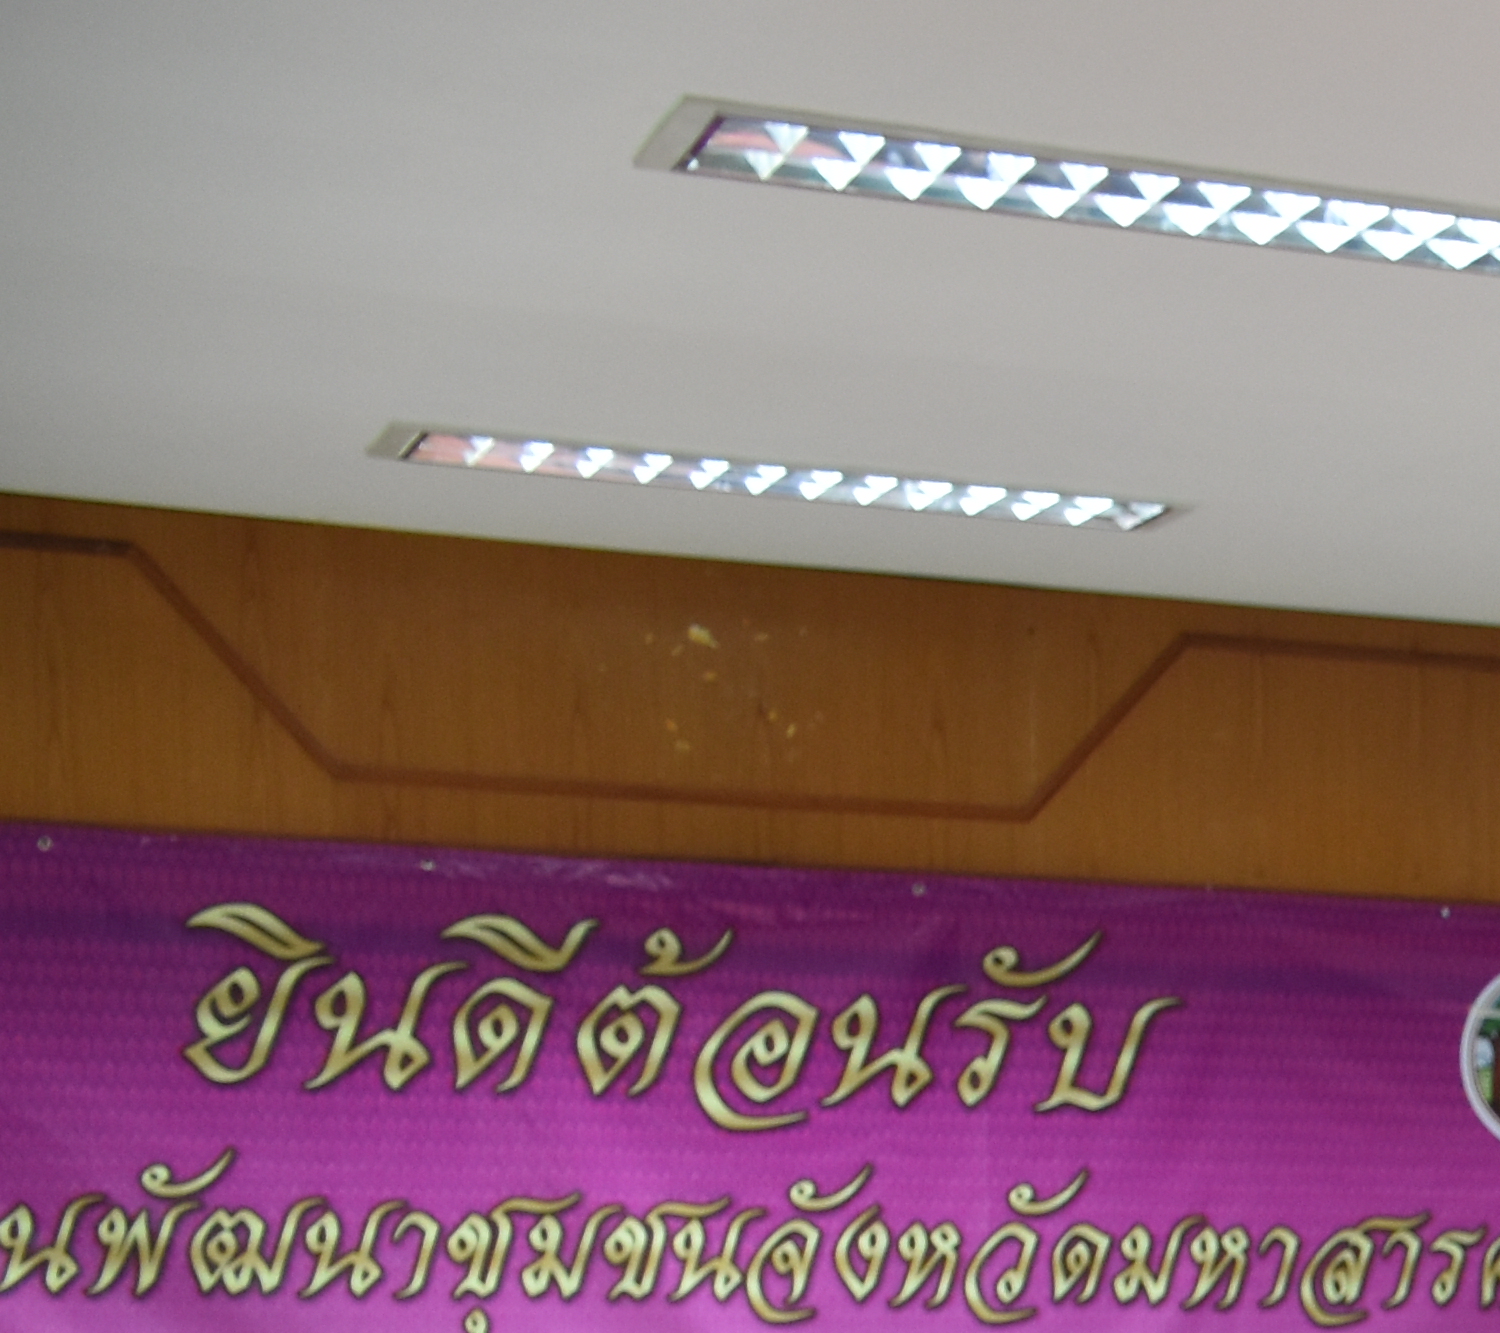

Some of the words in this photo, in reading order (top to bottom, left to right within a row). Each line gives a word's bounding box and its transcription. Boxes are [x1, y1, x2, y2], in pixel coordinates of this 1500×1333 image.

[183, 902, 1183, 1131] ยินดีต้อนรับ
